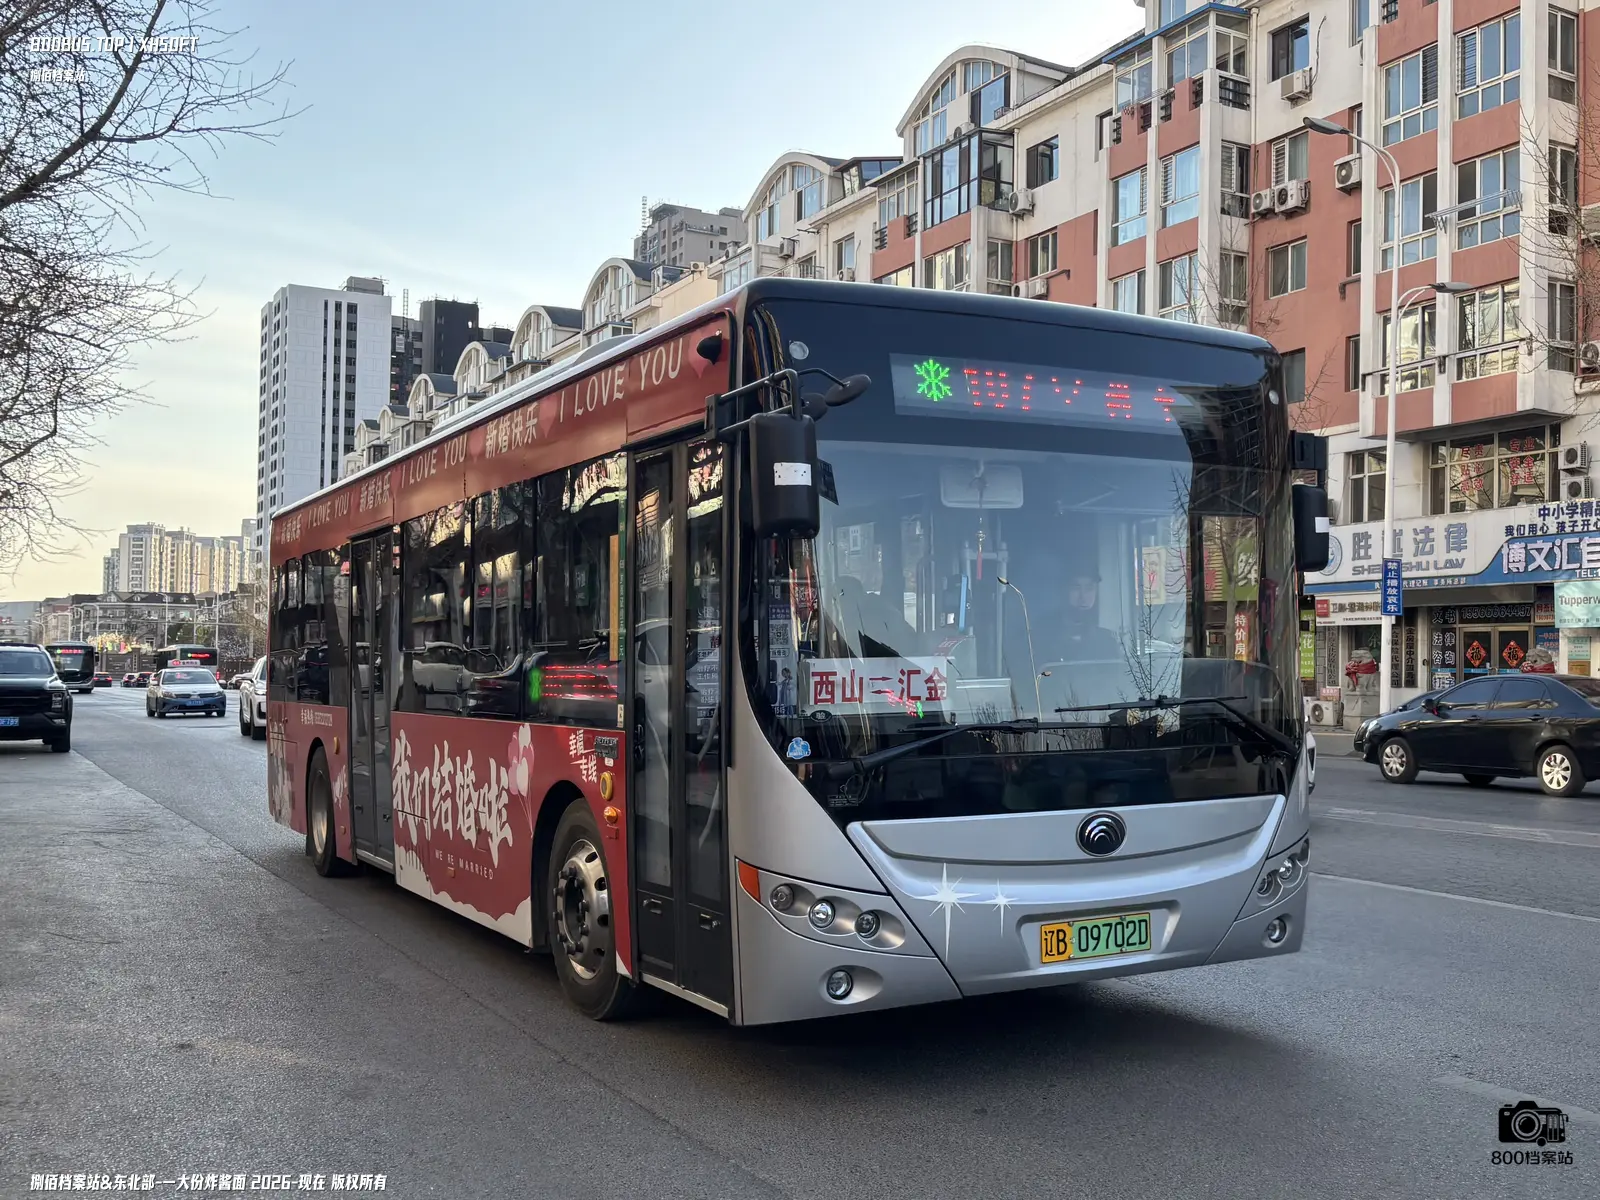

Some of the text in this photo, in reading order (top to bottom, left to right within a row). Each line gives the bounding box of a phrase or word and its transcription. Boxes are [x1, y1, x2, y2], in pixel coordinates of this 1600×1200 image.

[560, 338, 683, 422] I LOVE YOU
[485, 402, 538, 459] 新婚快乐
[401, 433, 468, 489] I LOVE YOU
[313, 501, 331, 527] LOVE
[334, 492, 350, 518] YOU
[360, 472, 391, 513] 新婚快乐
[1505, 518, 1600, 537] 我们用心 孩子开心
[1433, 558, 1466, 571] LAW
[1386, 561, 1399, 612] 禁止播放哀乐
[1234, 614, 1246, 655] 特价房
[1432, 606, 1456, 624] 文书
[1432, 632, 1456, 646] 法律
[811, 666, 948, 705] 西山 汇金
[391, 729, 513, 868] 我们结婚啦
[459, 858, 494, 880] MARRIED
